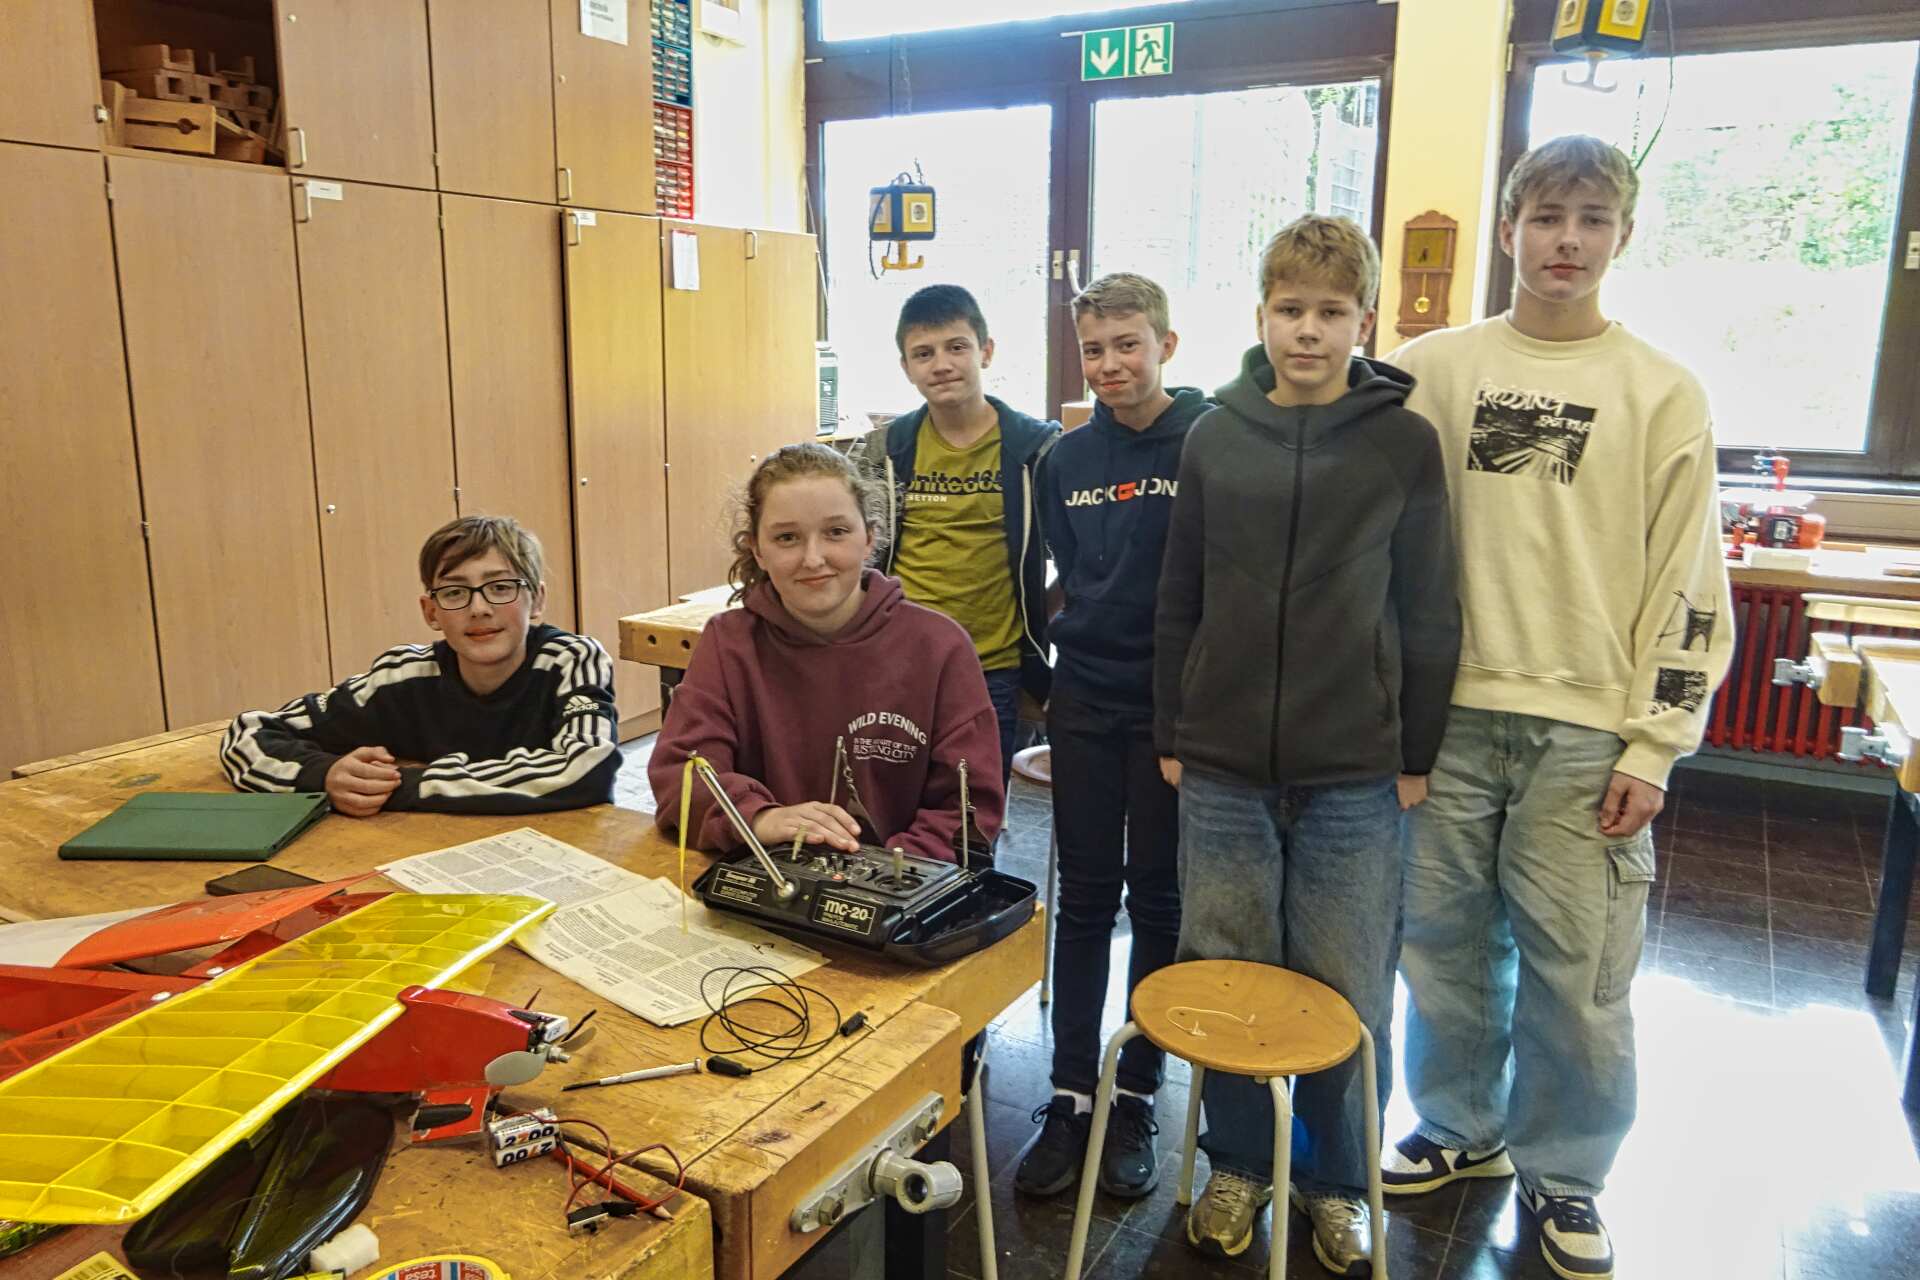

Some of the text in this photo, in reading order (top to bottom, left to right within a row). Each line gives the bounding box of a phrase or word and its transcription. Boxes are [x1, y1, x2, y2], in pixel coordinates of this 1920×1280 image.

[1065, 484, 1117, 506] JACK
[847, 711, 927, 745] WILD EVENING
